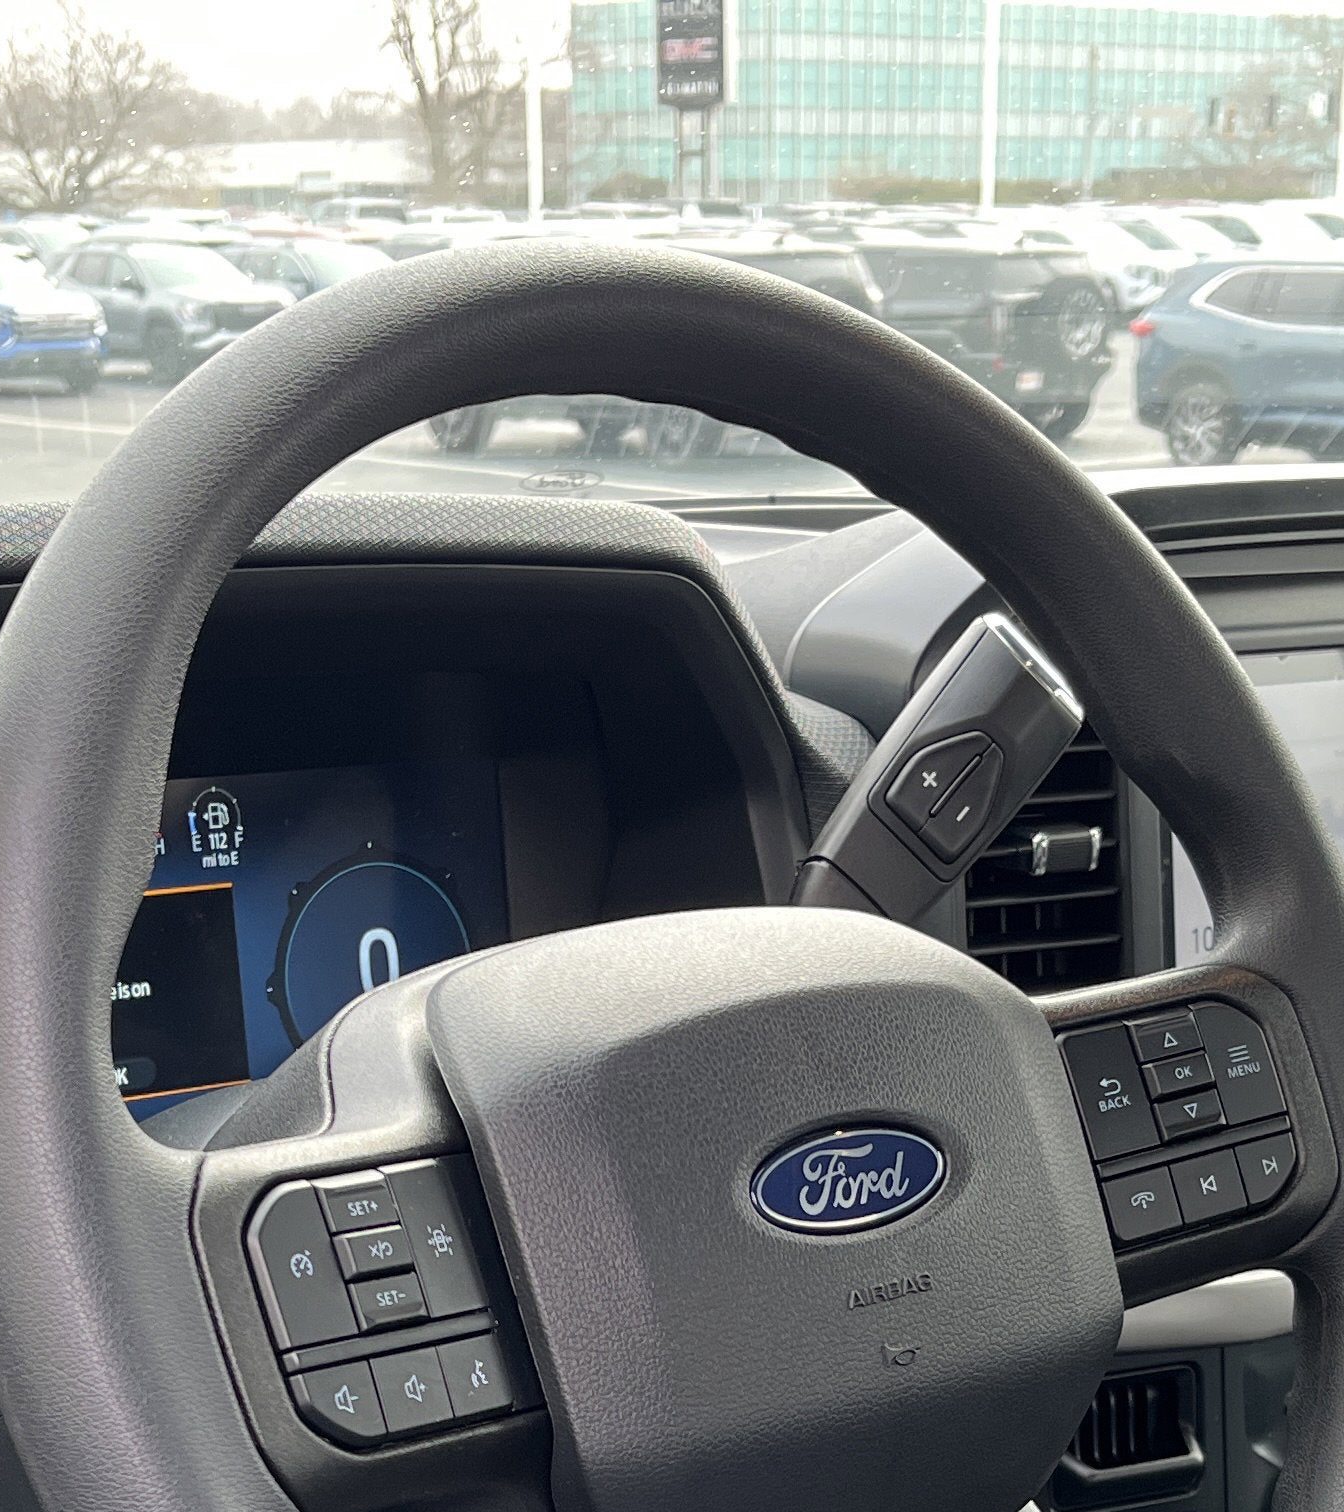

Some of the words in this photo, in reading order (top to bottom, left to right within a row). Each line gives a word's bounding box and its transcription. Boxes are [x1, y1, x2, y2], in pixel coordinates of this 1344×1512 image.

[192, 834, 202, 852] E
[208, 832, 228, 850] 112
[234, 831, 244, 848] F
[202, 854, 217, 868] mi
[218, 852, 230, 867] to
[230, 850, 239, 866] E
[359, 927, 399, 992] 0
[131, 981, 151, 997] on
[1174, 1065, 1193, 1080] OK
[1227, 1061, 1261, 1079] MENU
[1098, 1095, 1132, 1113] BACK
[799, 1143, 910, 1216] Ford
[348, 1201, 378, 1216] SET+
[376, 1290, 406, 1307] SET-
[848, 1271, 933, 1309] AIRBAG
